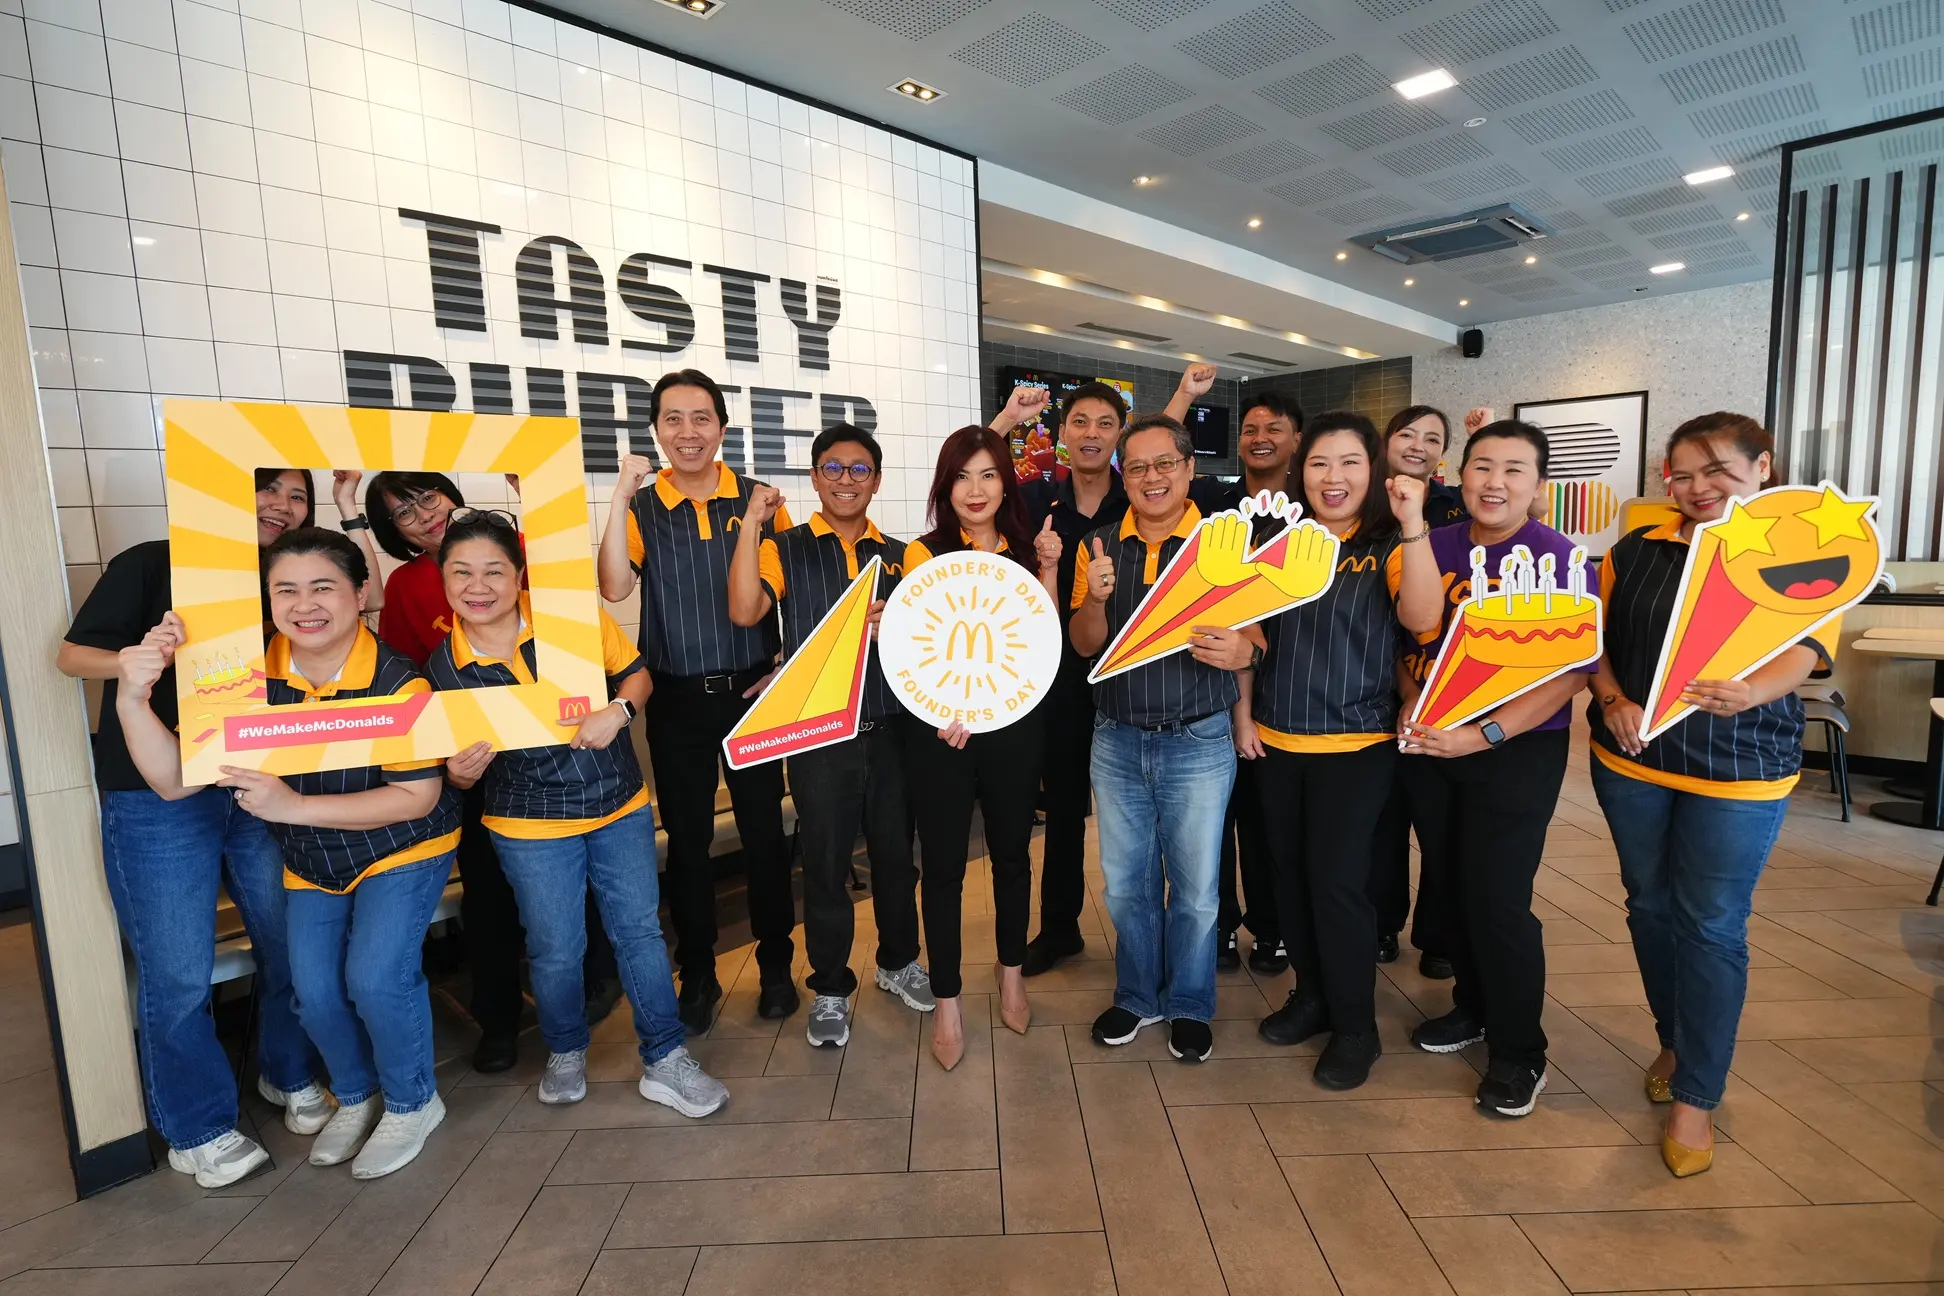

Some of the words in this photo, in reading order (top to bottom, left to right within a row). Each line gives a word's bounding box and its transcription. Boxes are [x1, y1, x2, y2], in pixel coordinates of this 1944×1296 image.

[398, 207, 841, 371] TASTY
[1014, 581, 1045, 616] DAY
[1004, 678, 1037, 712] DAY
[238, 714, 394, 739] #WeMakeMcDonalds
[738, 720, 844, 755] #WeMakeMcDonalds
